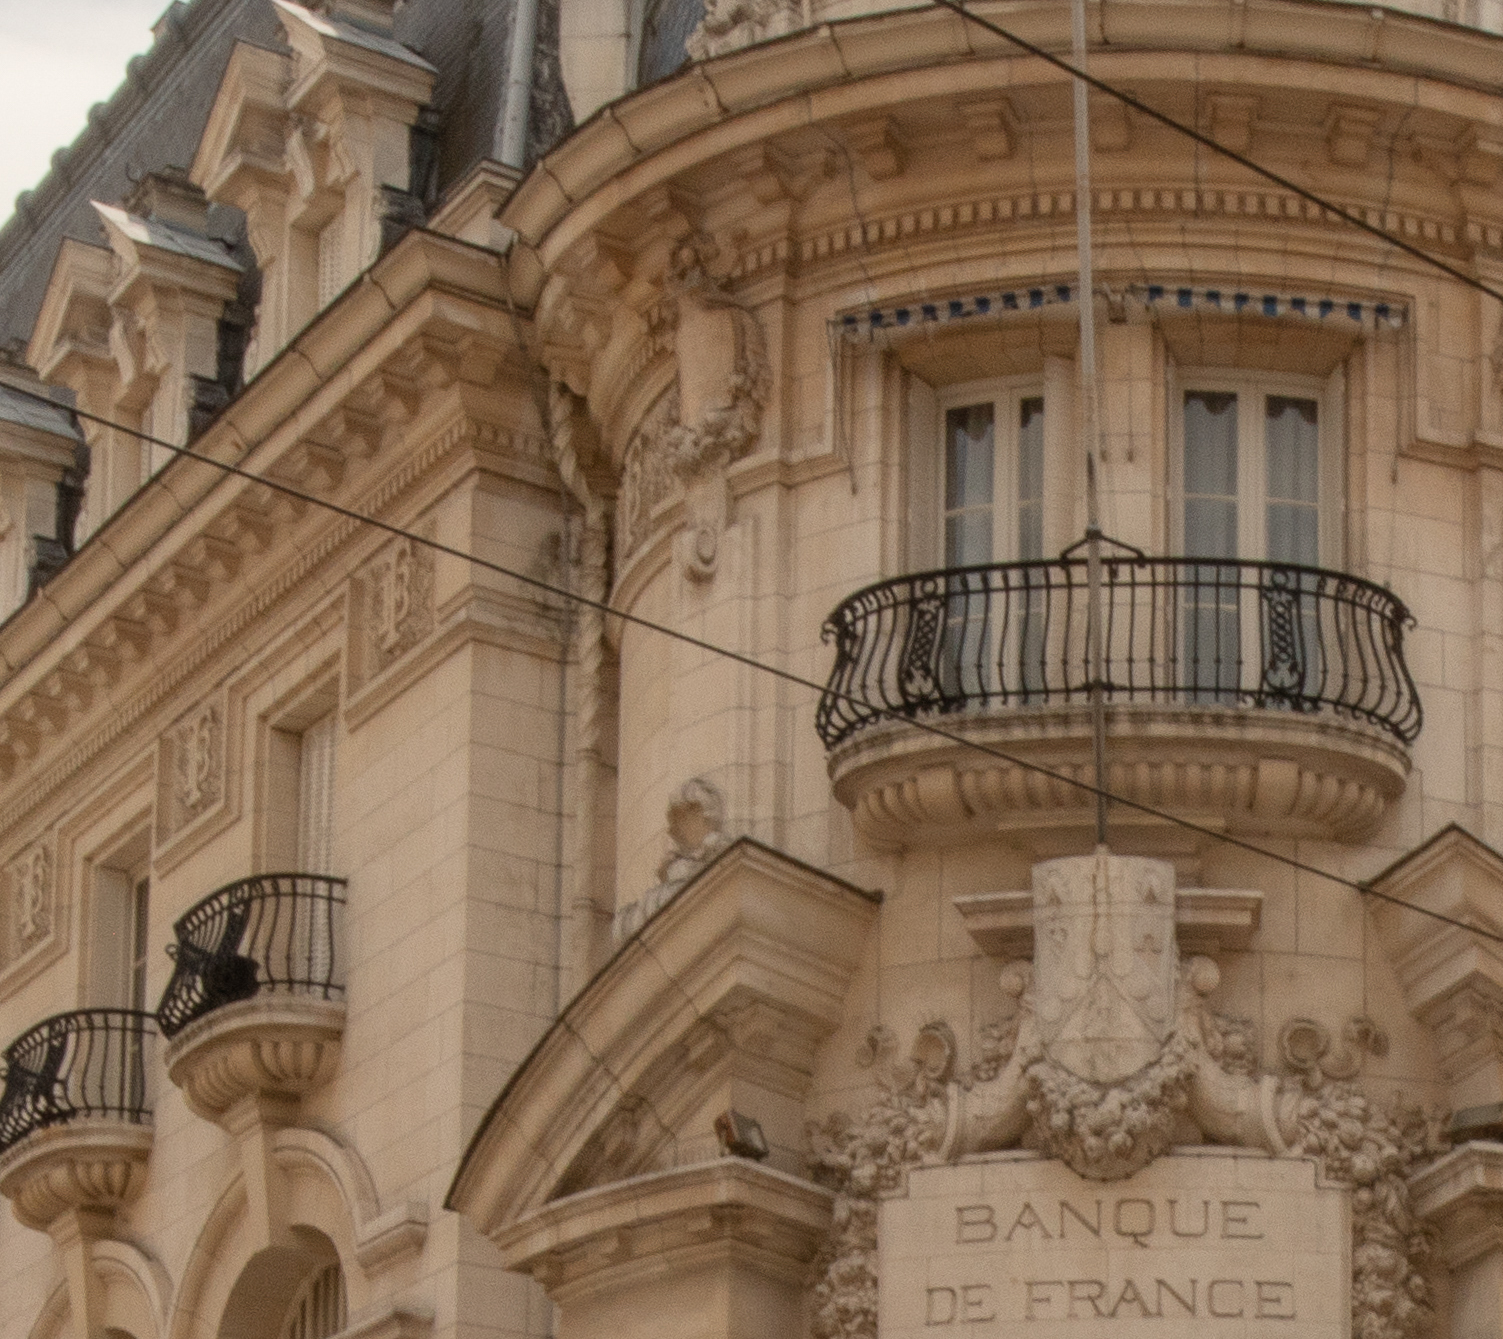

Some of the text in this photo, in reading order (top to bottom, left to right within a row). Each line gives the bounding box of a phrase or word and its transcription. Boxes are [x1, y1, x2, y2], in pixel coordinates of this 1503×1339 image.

[954, 1197, 1265, 1249] BANQUE
[923, 1278, 1297, 1327] DE FRANCE
